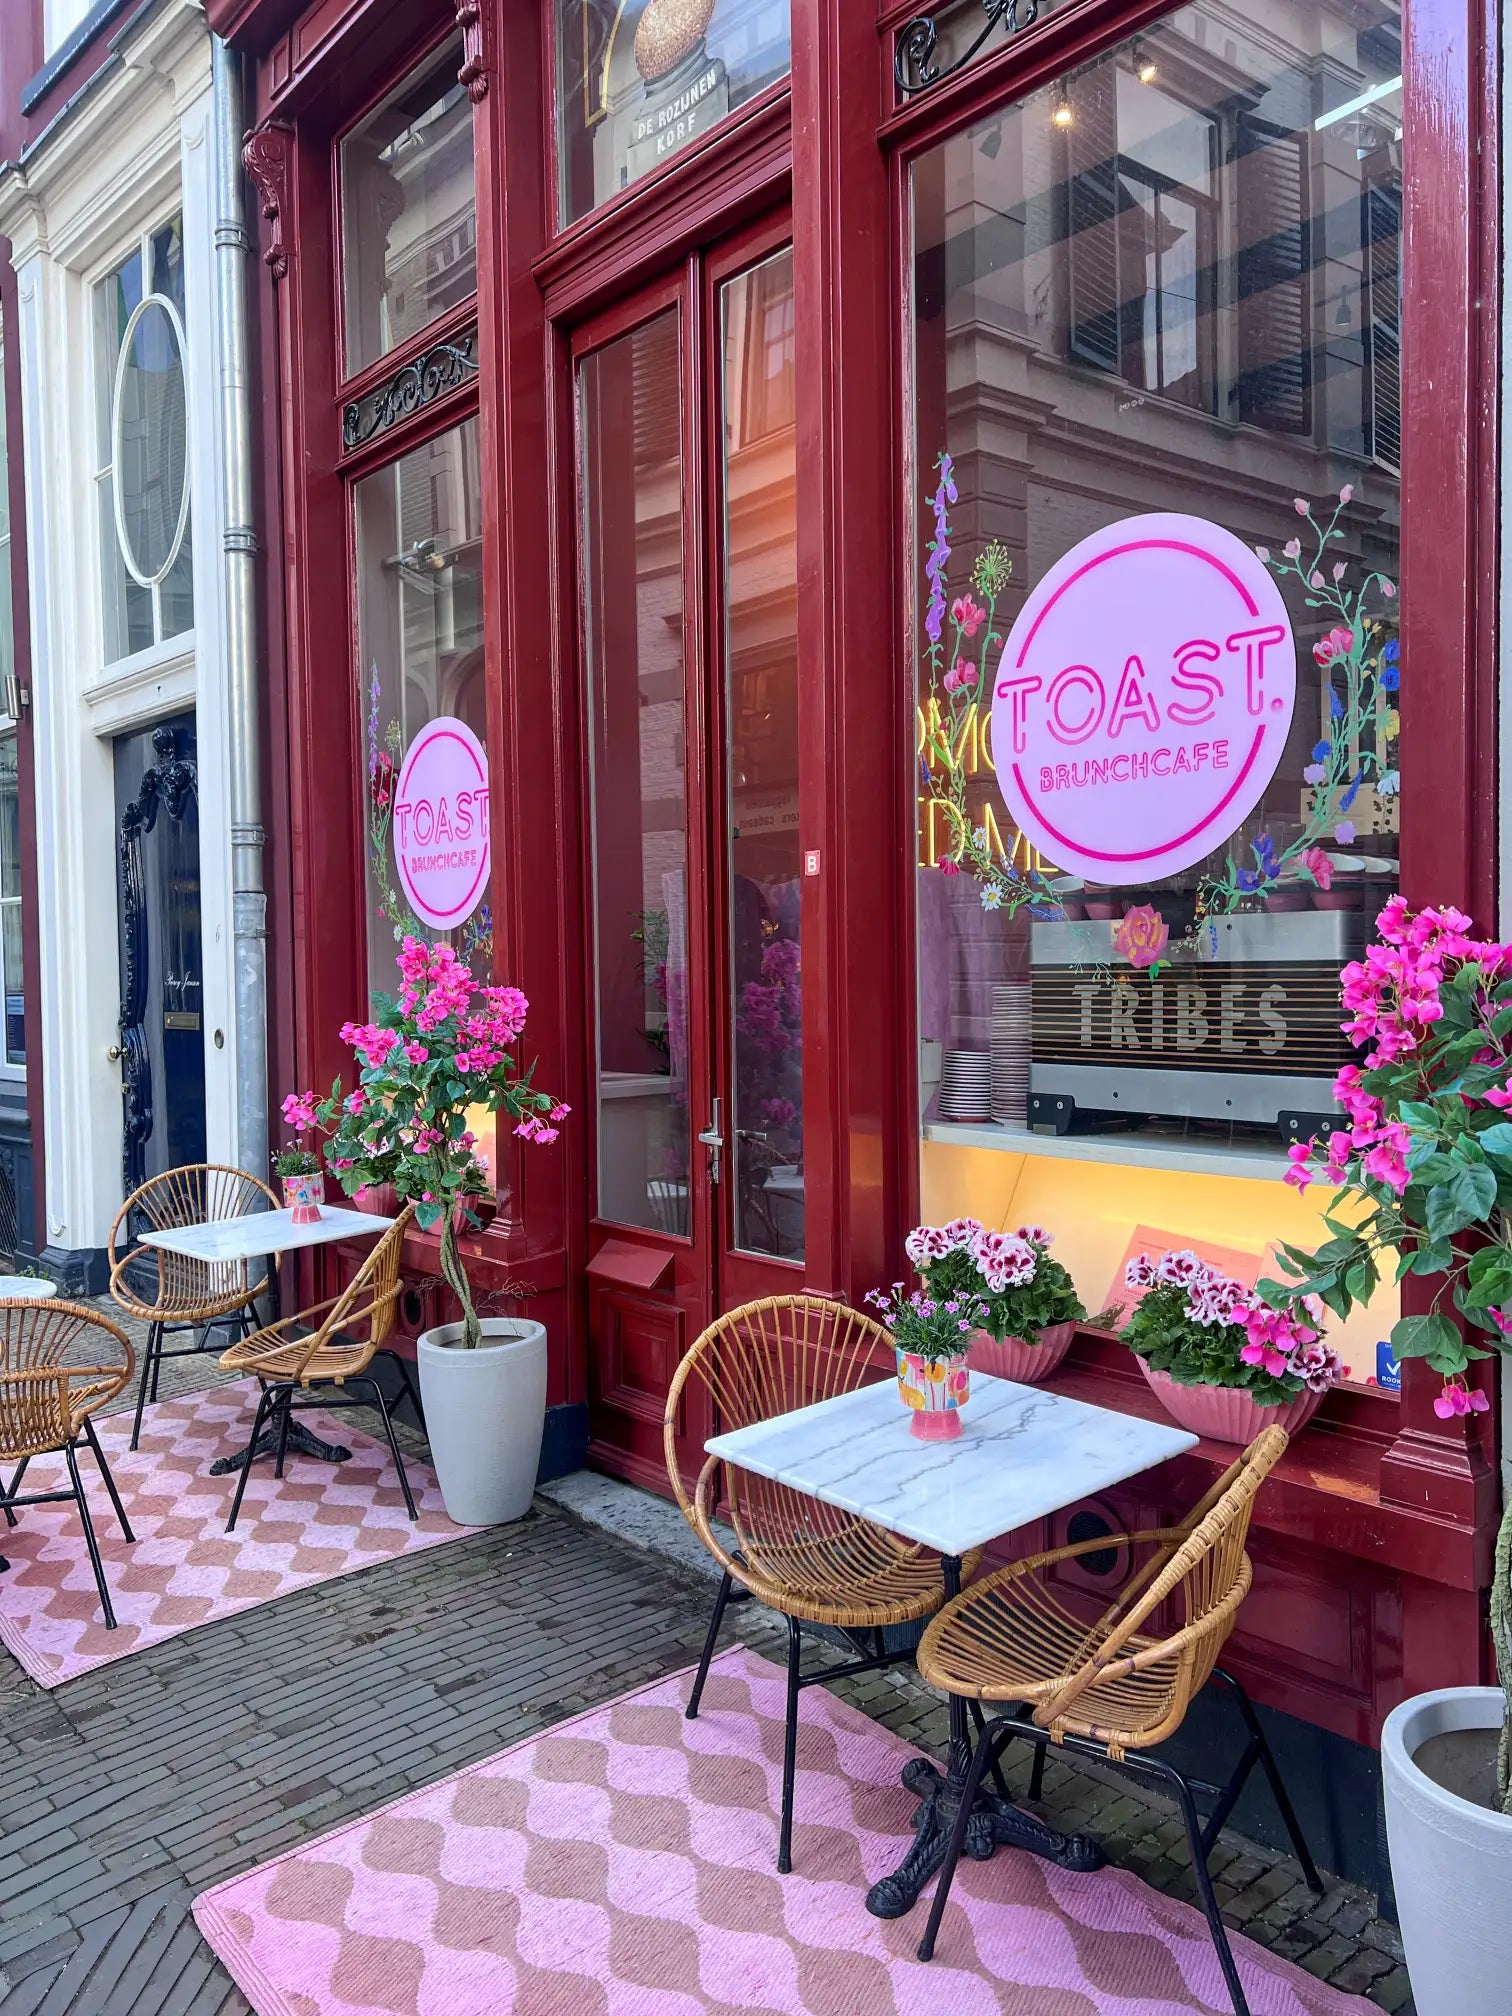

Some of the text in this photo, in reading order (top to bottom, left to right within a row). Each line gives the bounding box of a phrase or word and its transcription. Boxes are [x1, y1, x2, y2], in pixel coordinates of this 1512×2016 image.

[638, 68, 716, 140] DE ROZIJNEN
[657, 113, 697, 155] KORF
[1040, 740, 1230, 793] BRUNCHCAFE
[411, 849, 477, 874] BRUNCHCAFE
[807, 855, 817, 873] B
[1071, 983, 1288, 1056] TRIBES
